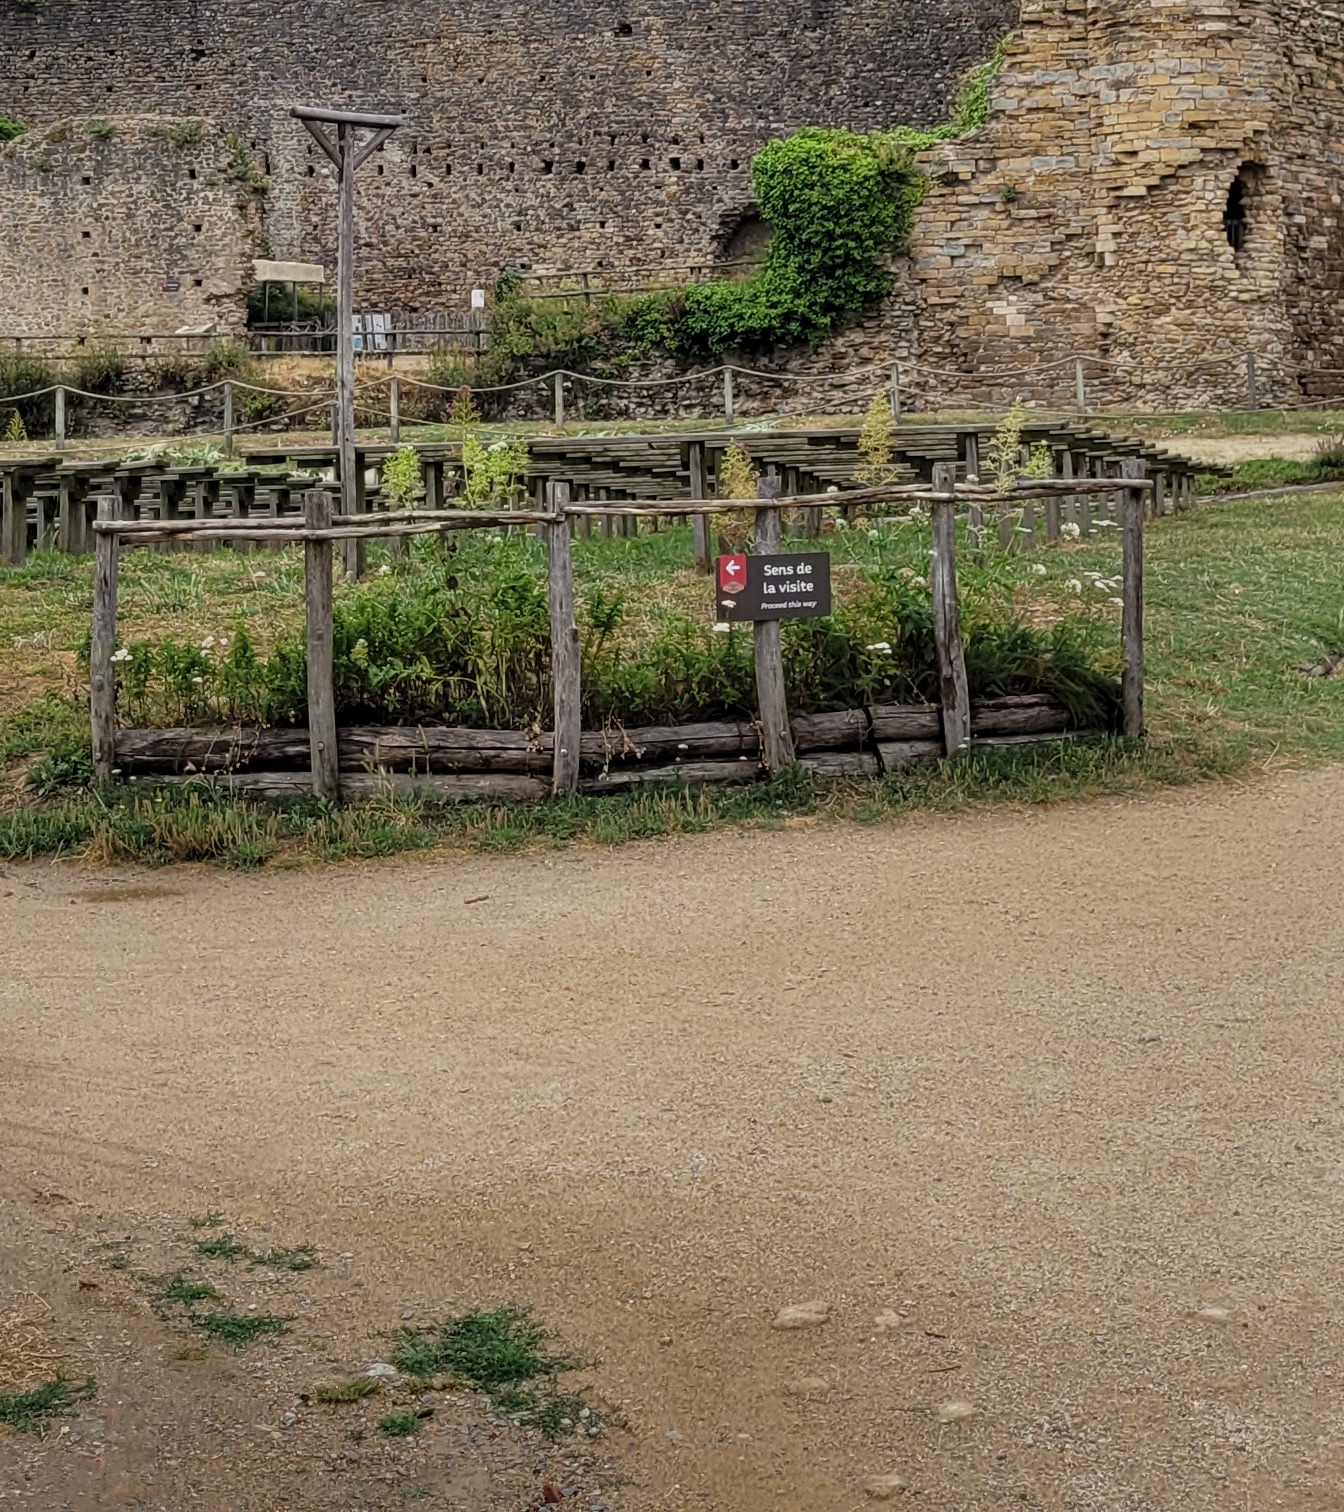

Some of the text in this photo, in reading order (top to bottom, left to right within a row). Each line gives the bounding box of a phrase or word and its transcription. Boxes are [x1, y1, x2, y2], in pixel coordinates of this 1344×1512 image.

[763, 562, 812, 576] Sens de
[763, 580, 814, 594] la visite
[761, 601, 787, 609] Proceed
[789, 600, 801, 608] this
